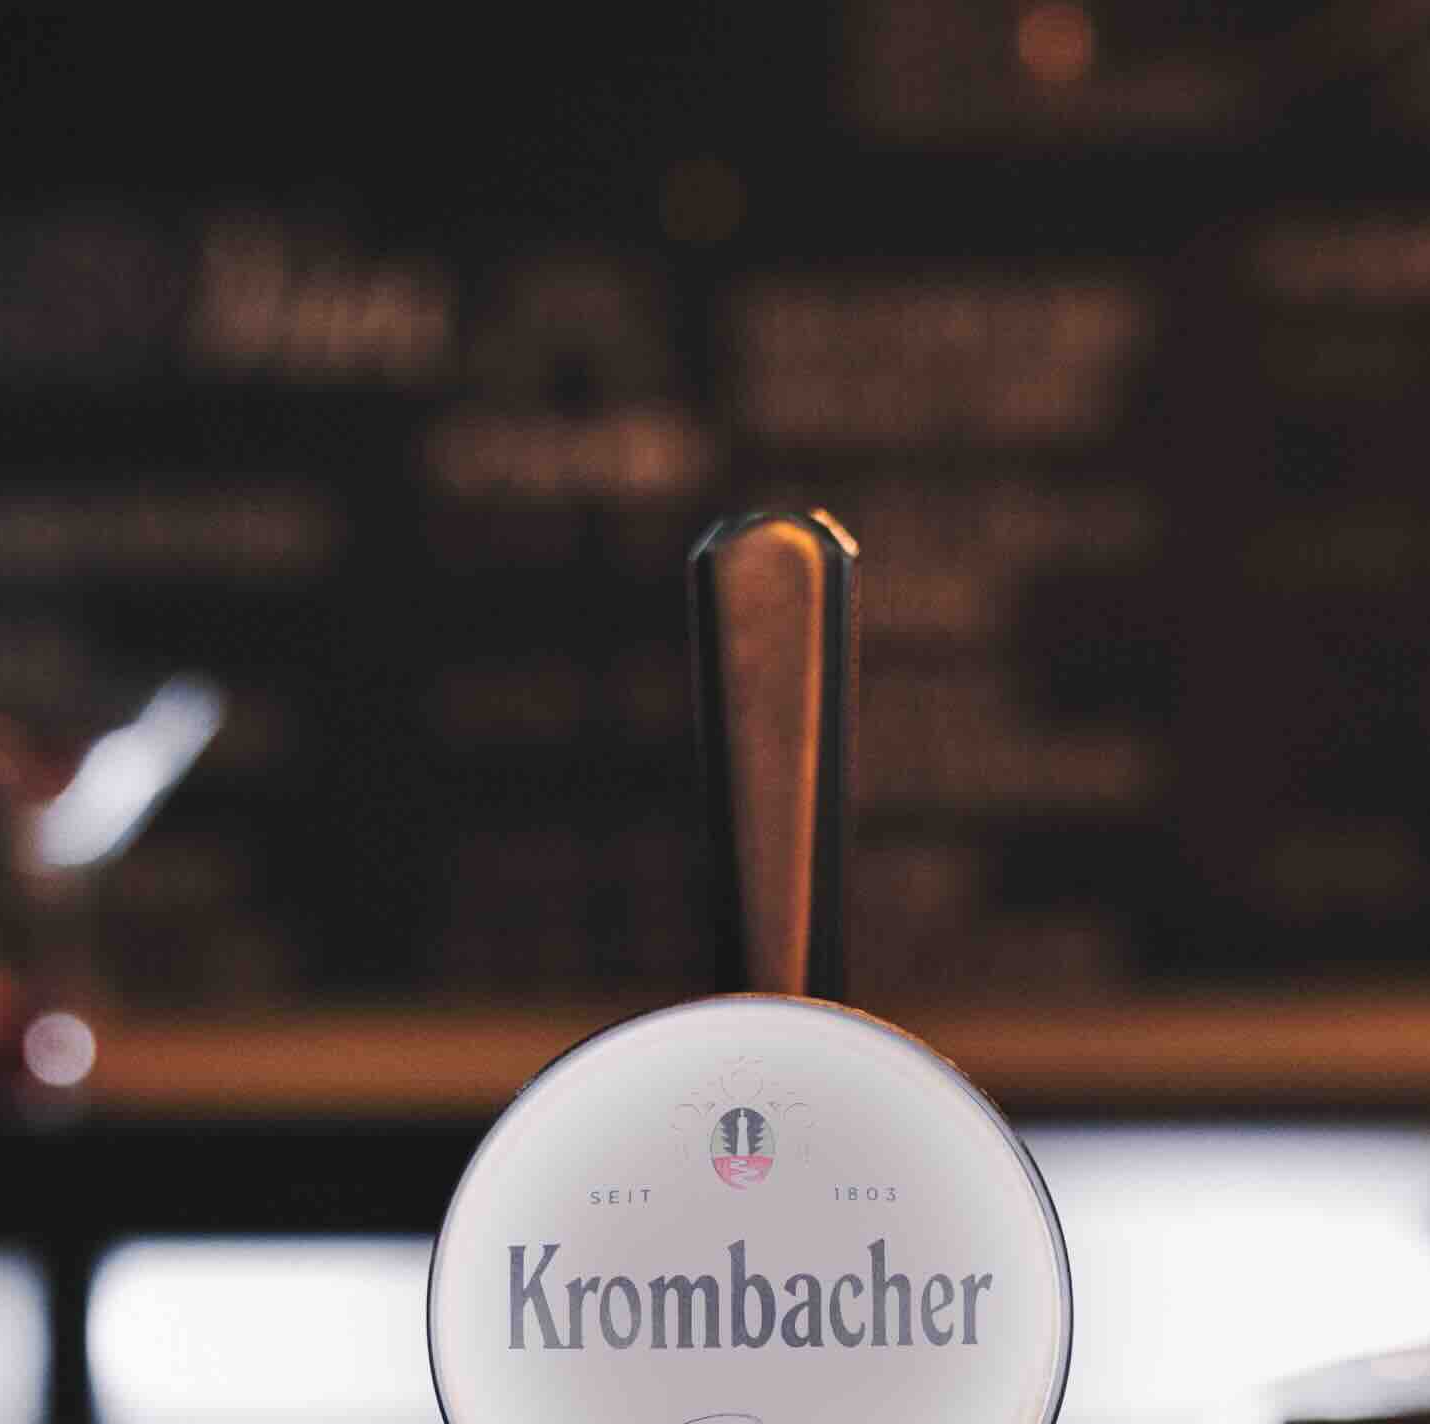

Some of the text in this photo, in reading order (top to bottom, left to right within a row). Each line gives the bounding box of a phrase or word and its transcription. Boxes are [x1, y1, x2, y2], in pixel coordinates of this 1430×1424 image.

[589, 1186, 898, 1206] SEIT 1803
[508, 1238, 993, 1350] Krombacher
